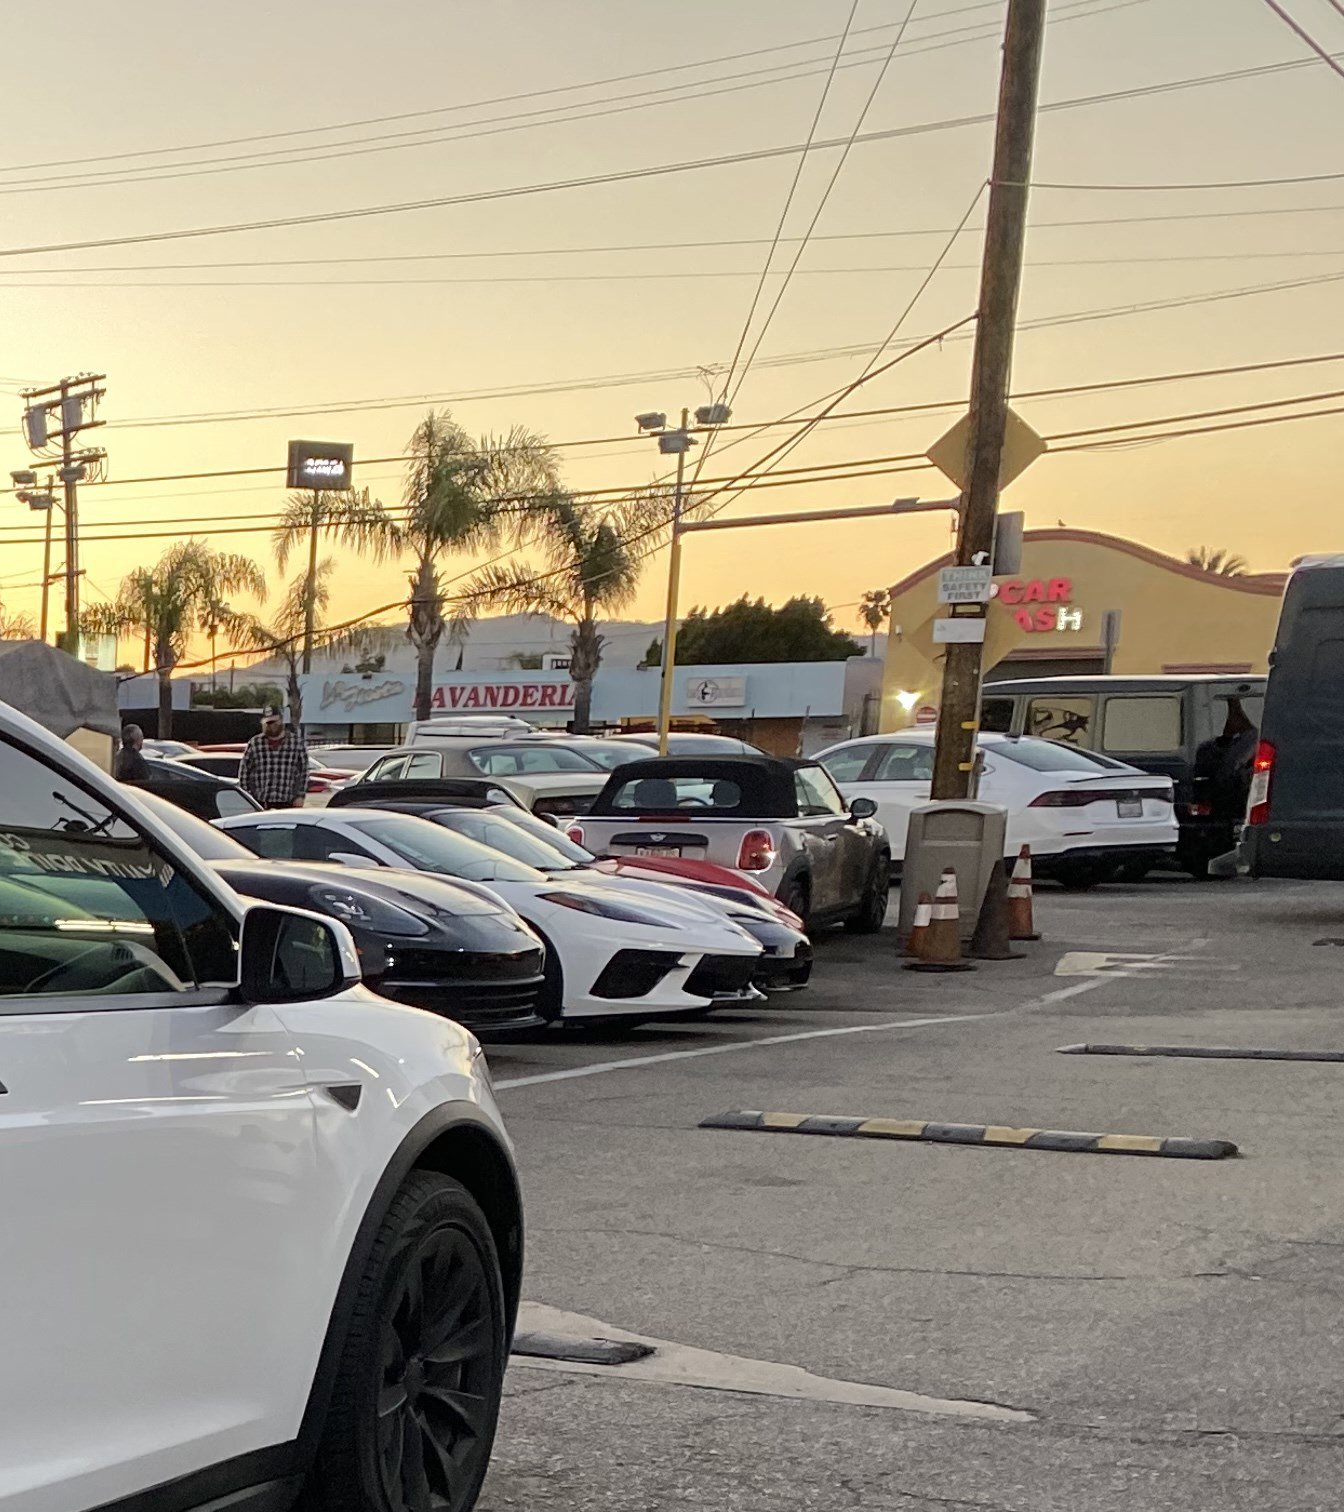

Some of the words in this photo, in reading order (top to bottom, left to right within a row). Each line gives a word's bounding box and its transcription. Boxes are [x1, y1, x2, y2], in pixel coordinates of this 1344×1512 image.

[942, 582, 987, 591] SAFETY
[947, 591, 981, 600] FIRST
[999, 577, 1072, 605] CAR
[1014, 606, 1082, 632] ASH
[413, 684, 576, 708] AVANDERI
